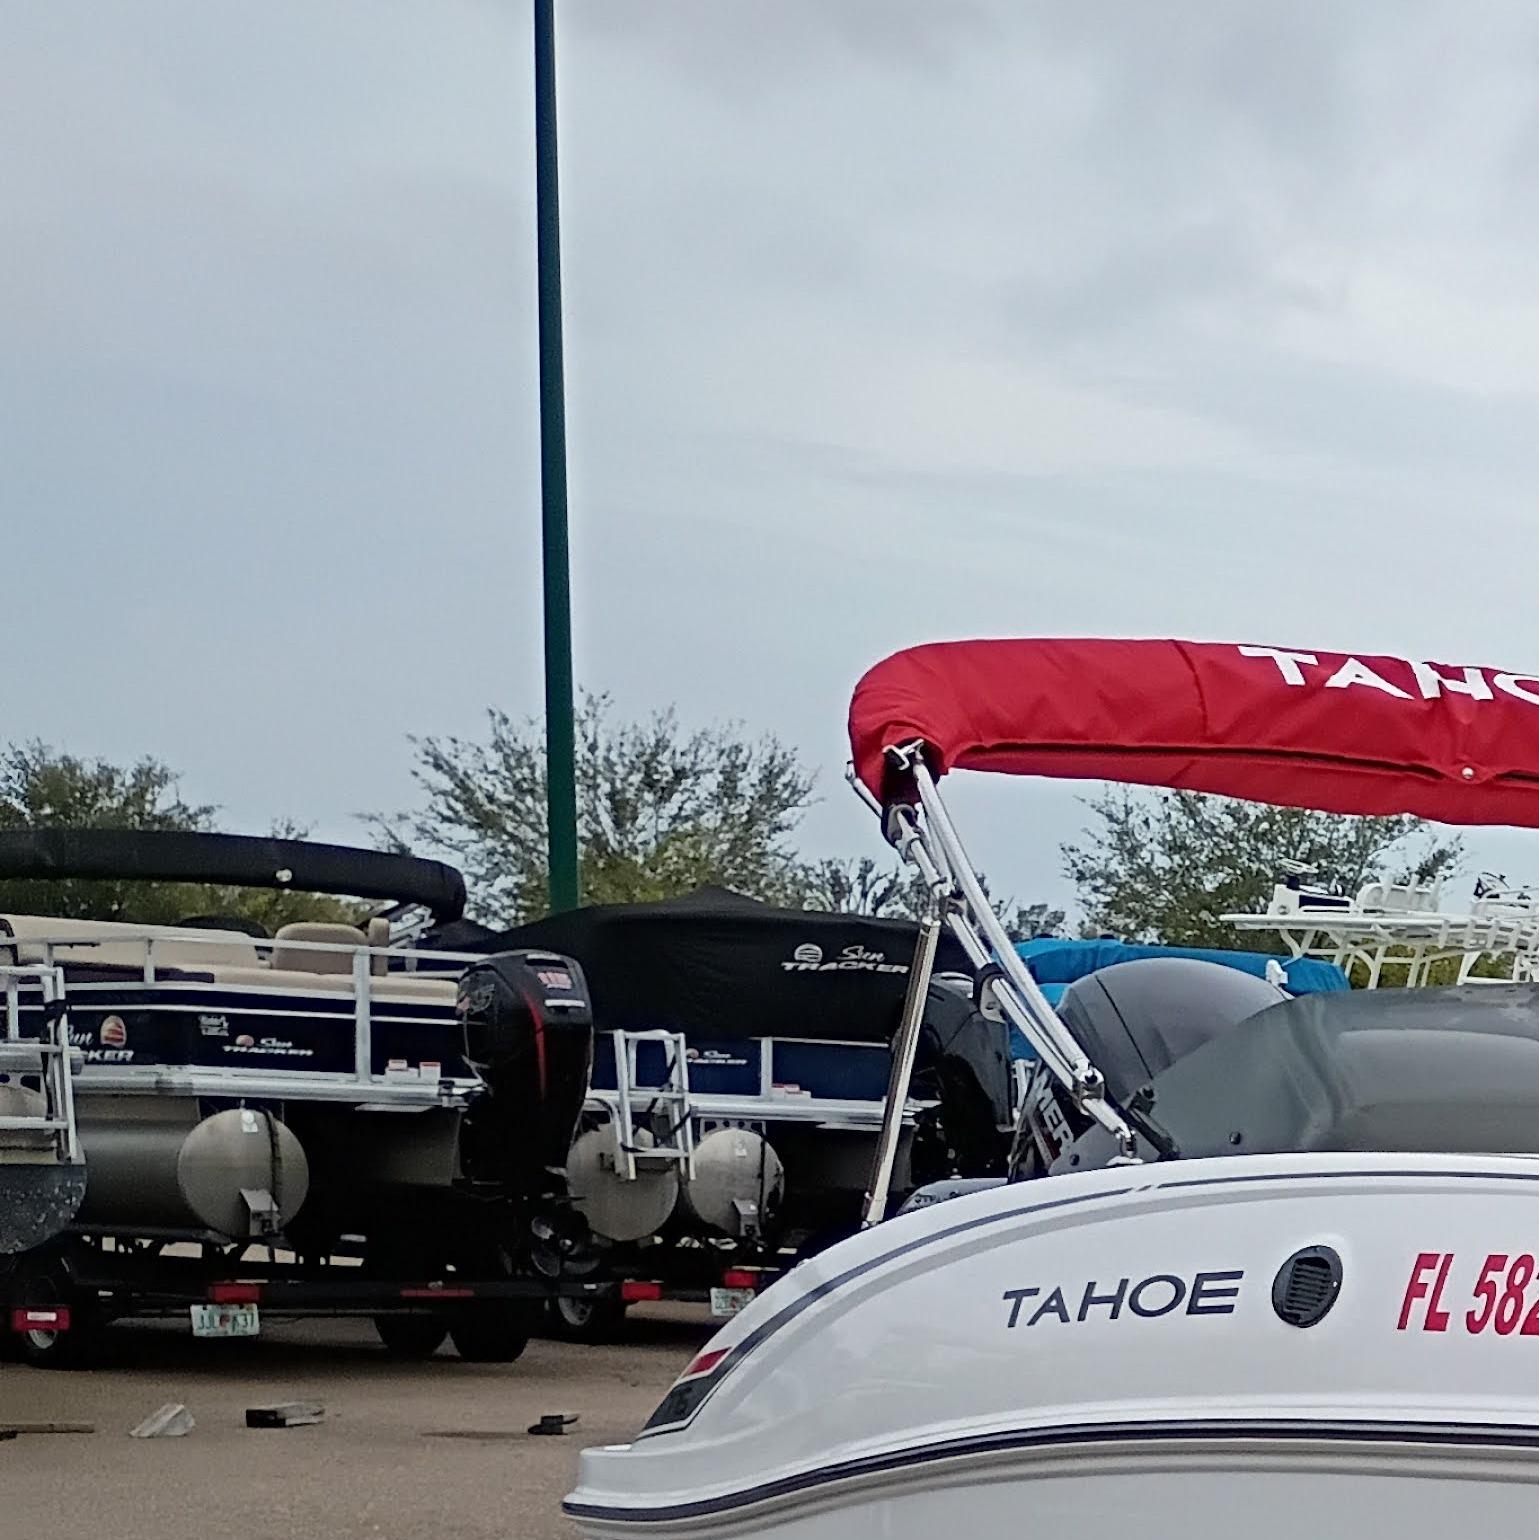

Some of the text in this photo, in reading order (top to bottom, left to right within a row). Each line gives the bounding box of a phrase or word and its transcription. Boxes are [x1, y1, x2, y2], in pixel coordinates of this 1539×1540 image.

[781, 962, 909, 974] TRACKER
[838, 945, 885, 961] Sun
[1003, 1270, 1244, 1328] TAHOE
[1397, 1253, 1454, 1332] FL
